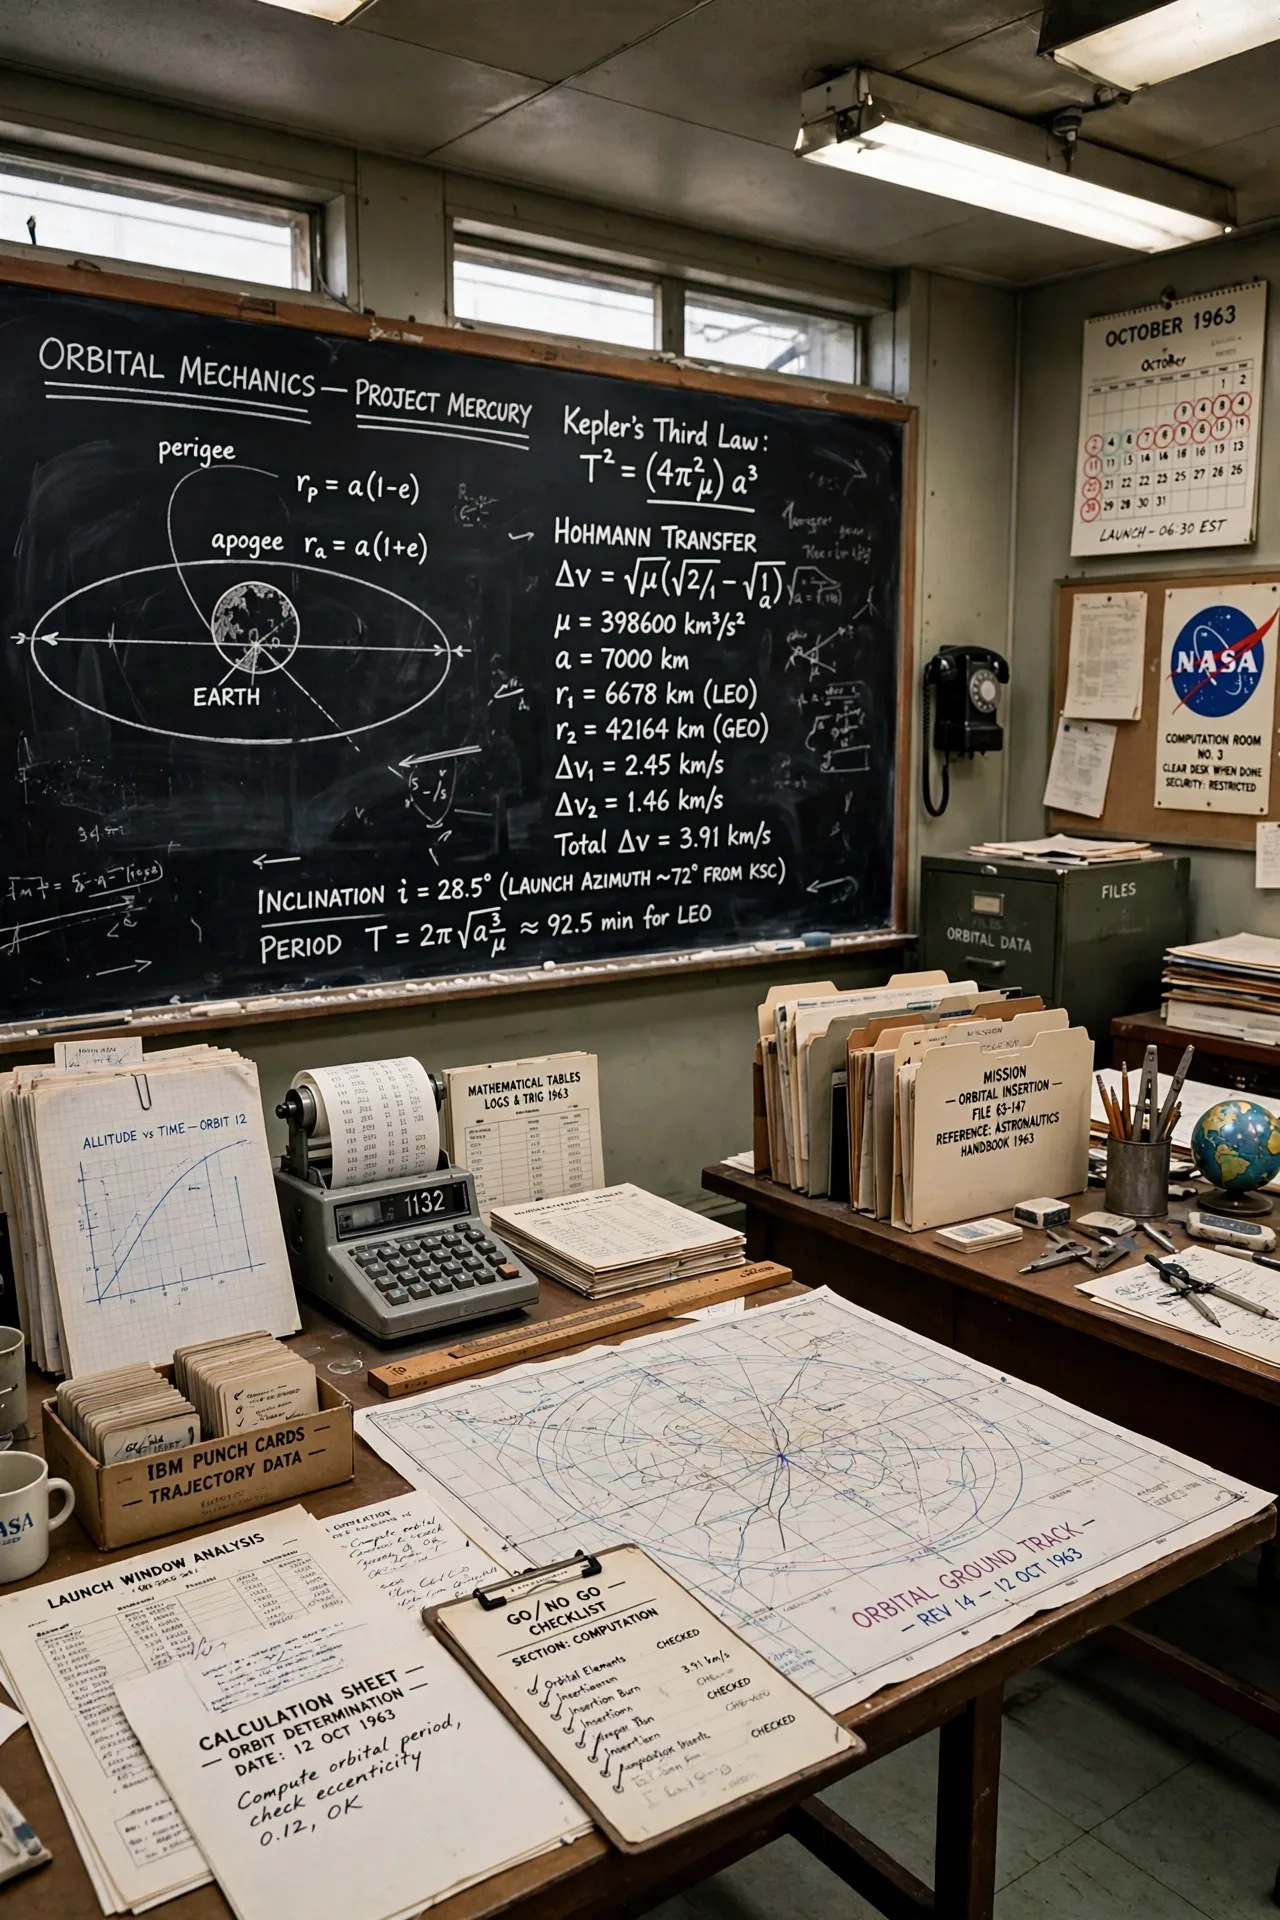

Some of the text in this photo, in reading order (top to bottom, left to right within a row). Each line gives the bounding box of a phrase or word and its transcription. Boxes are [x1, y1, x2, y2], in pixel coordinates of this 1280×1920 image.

[1106, 305, 1236, 347] OCTOBER 1963
[38, 337, 532, 428] ORBITAL MECHANICS PROJECT MERCURY
[564, 405, 644, 445] Kepler's
[653, 418, 707, 447] Third
[158, 437, 236, 467] perigee
[1156, 496, 1166, 506] 31
[554, 516, 757, 553] HOHMANN TRANSFER
[1100, 526, 1146, 542] LAUNCH
[1200, 518, 1228, 534] EST
[211, 530, 284, 564] apogee
[600, 610, 676, 634] 398600
[601, 646, 652, 670] 7000
[661, 646, 690, 670] km
[1176, 650, 1258, 674] NASA
[194, 687, 260, 707] EARTH
[605, 678, 758, 710] 6678 km (LEO)
[605, 713, 769, 744] 42164 km (GEO)
[1166, 733, 1262, 746] COMPUTATION ROOM
[625, 750, 725, 780] 2.45 km/s
[1217, 749, 1224, 760] 3
[1162, 763, 1262, 778] CLEAR DESK WHEN DONE
[628, 785, 724, 815] 1.46 km/s
[1209, 780, 1256, 792] RESTRICTED
[554, 828, 607, 857] Total
[680, 826, 718, 850] 3.91
[728, 820, 772, 850] km/s
[259, 885, 384, 914] INCLINATION
[500, 871, 574, 901] (LAUNCH
[581, 869, 651, 891] AZIMUTH
[704, 865, 742, 883] FROM
[750, 856, 786, 885] KSC)
[1102, 882, 1136, 899] FILES
[260, 904, 712, 964] PERIOD T 92.5 min for LEO
[946, 926, 1032, 952] ORBITAL DATA
[468, 1072, 581, 1097] MATHEMATICAL TABLES
[983, 1065, 1027, 1085] MISSION
[484, 1088, 569, 1110] LOGS & TRIG 1963
[958, 1079, 1050, 1106] ORBITAL INSERTION
[936, 1112, 1060, 1146] REFERENCE: ASTRONAUTICS
[972, 1106, 992, 1122] FILE
[83, 1114, 248, 1150] ALLITUDE vs TIME ORBIT 12
[961, 1132, 1035, 1158] HANDBOOK 1963
[404, 1190, 446, 1217] 1132
[147, 1457, 183, 1482] IBM
[193, 1441, 248, 1470] PUNCH
[255, 1426, 306, 1452] CARDS
[149, 1462, 256, 1504] TRAJECTORY
[263, 1450, 302, 1474] DATA
[0, 1512, 34, 1538] ASA
[47, 1580, 114, 1609] LAUNCH
[120, 1558, 186, 1585] WINDOW
[193, 1532, 266, 1564] ANALYSIS
[852, 1522, 1085, 1628] ORBITAL GROUND TRACK
[576, 1586, 601, 1601] GO
[917, 1547, 1084, 1628] REV 14 12 OCT 1963
[529, 1602, 606, 1636] CHECKLIST
[512, 1608, 659, 1667] SECTION: COMPUTATION
[656, 1628, 700, 1650] CHECKED
[681, 1660, 704, 1674] 3.91
[707, 1677, 751, 1700] CHECKED
[198, 1669, 400, 1752] CALCULATION SHEET
[228, 1688, 405, 1760] ORBIT DETERMINATION
[751, 1714, 796, 1738] CHECKED
[235, 1709, 396, 1777] DATE: 12 OCT 1963
[238, 1713, 461, 1810] Compute orbital period,
[250, 1795, 306, 1828] check
[260, 1794, 363, 1847] 0.12, OK
